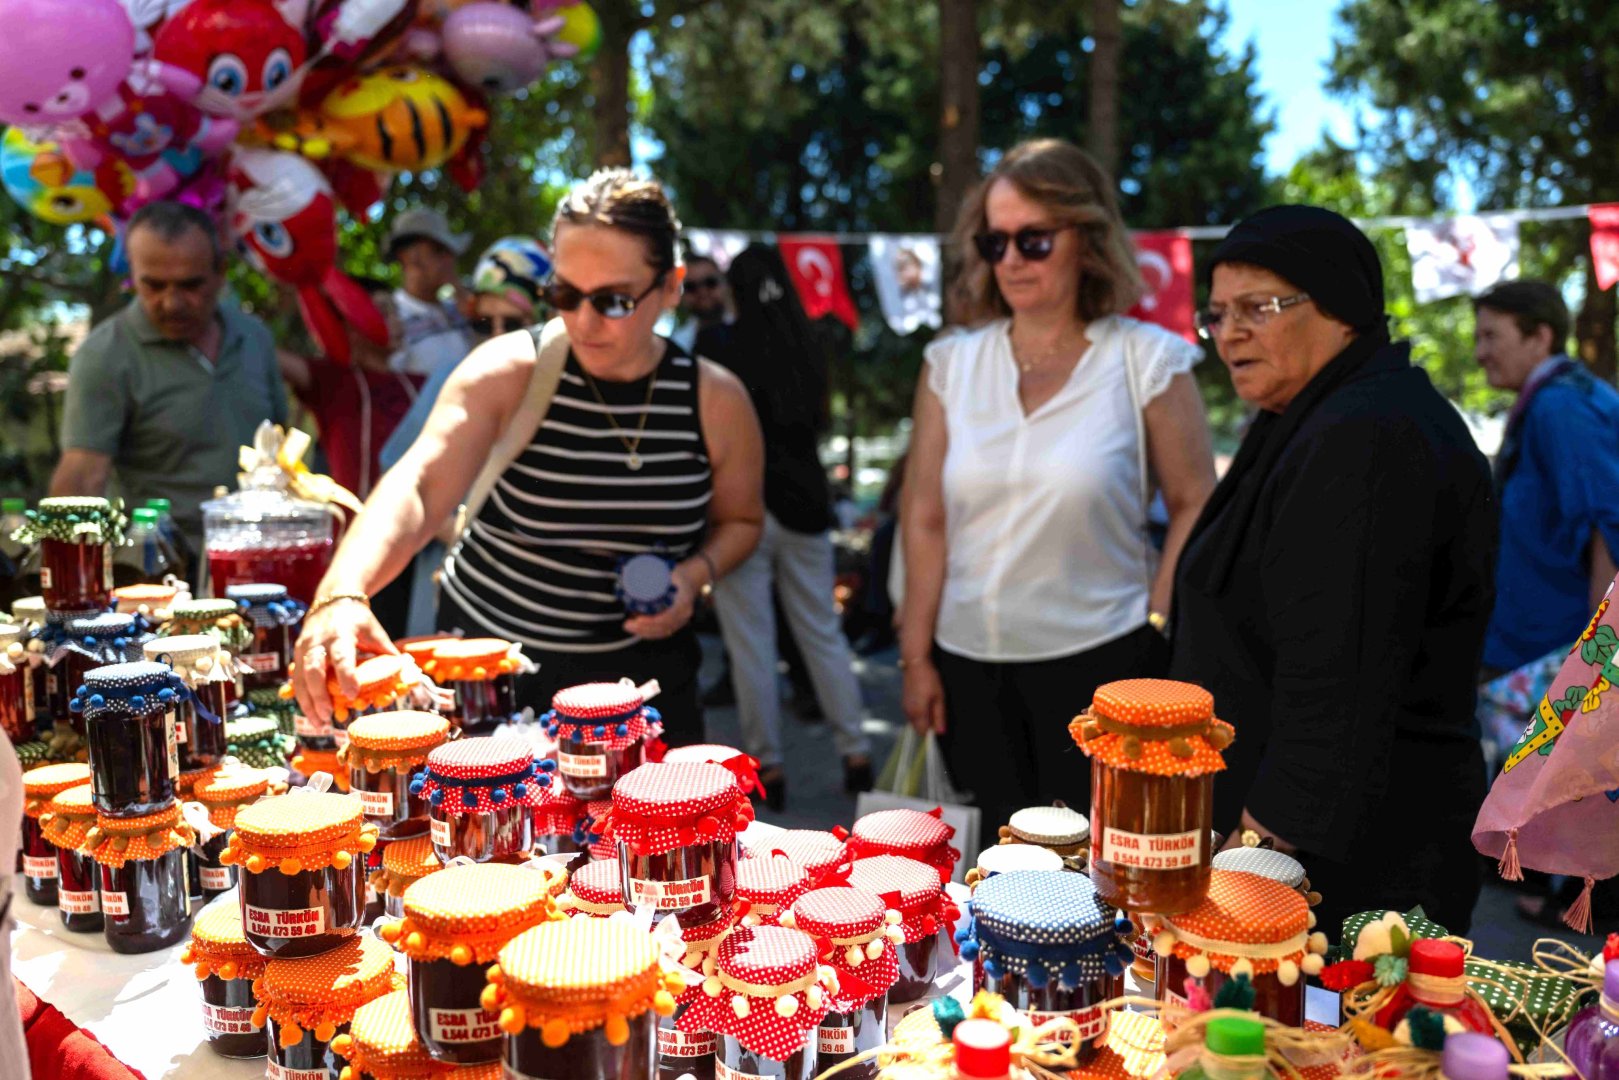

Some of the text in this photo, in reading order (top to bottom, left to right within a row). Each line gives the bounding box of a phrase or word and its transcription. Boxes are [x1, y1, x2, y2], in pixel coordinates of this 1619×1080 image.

[1110, 833, 1195, 851] ESRA TÜRKÖN
[1143, 856, 1162, 867] 473
[1165, 856, 1178, 867] 59
[1181, 855, 1192, 865] 48
[663, 879, 705, 896] TÜRKÖN
[661, 898, 677, 908] 473
[679, 896, 690, 906] 59
[692, 893, 703, 904] 48
[249, 908, 319, 924] ESRA TÜRKÖN
[273, 926, 289, 936] 473
[291, 926, 303, 936] 59
[305, 924, 317, 934] 48
[437, 1012, 467, 1026] ESRA
[228, 1022, 238, 1032] 59
[240, 1022, 252, 1032] 48
[472, 1026, 491, 1038] 473
[818, 1029, 848, 1039] RKÖN
[679, 1045, 696, 1056] 473
[697, 1044, 708, 1055] 59
[822, 1043, 845, 1053] 59 48
